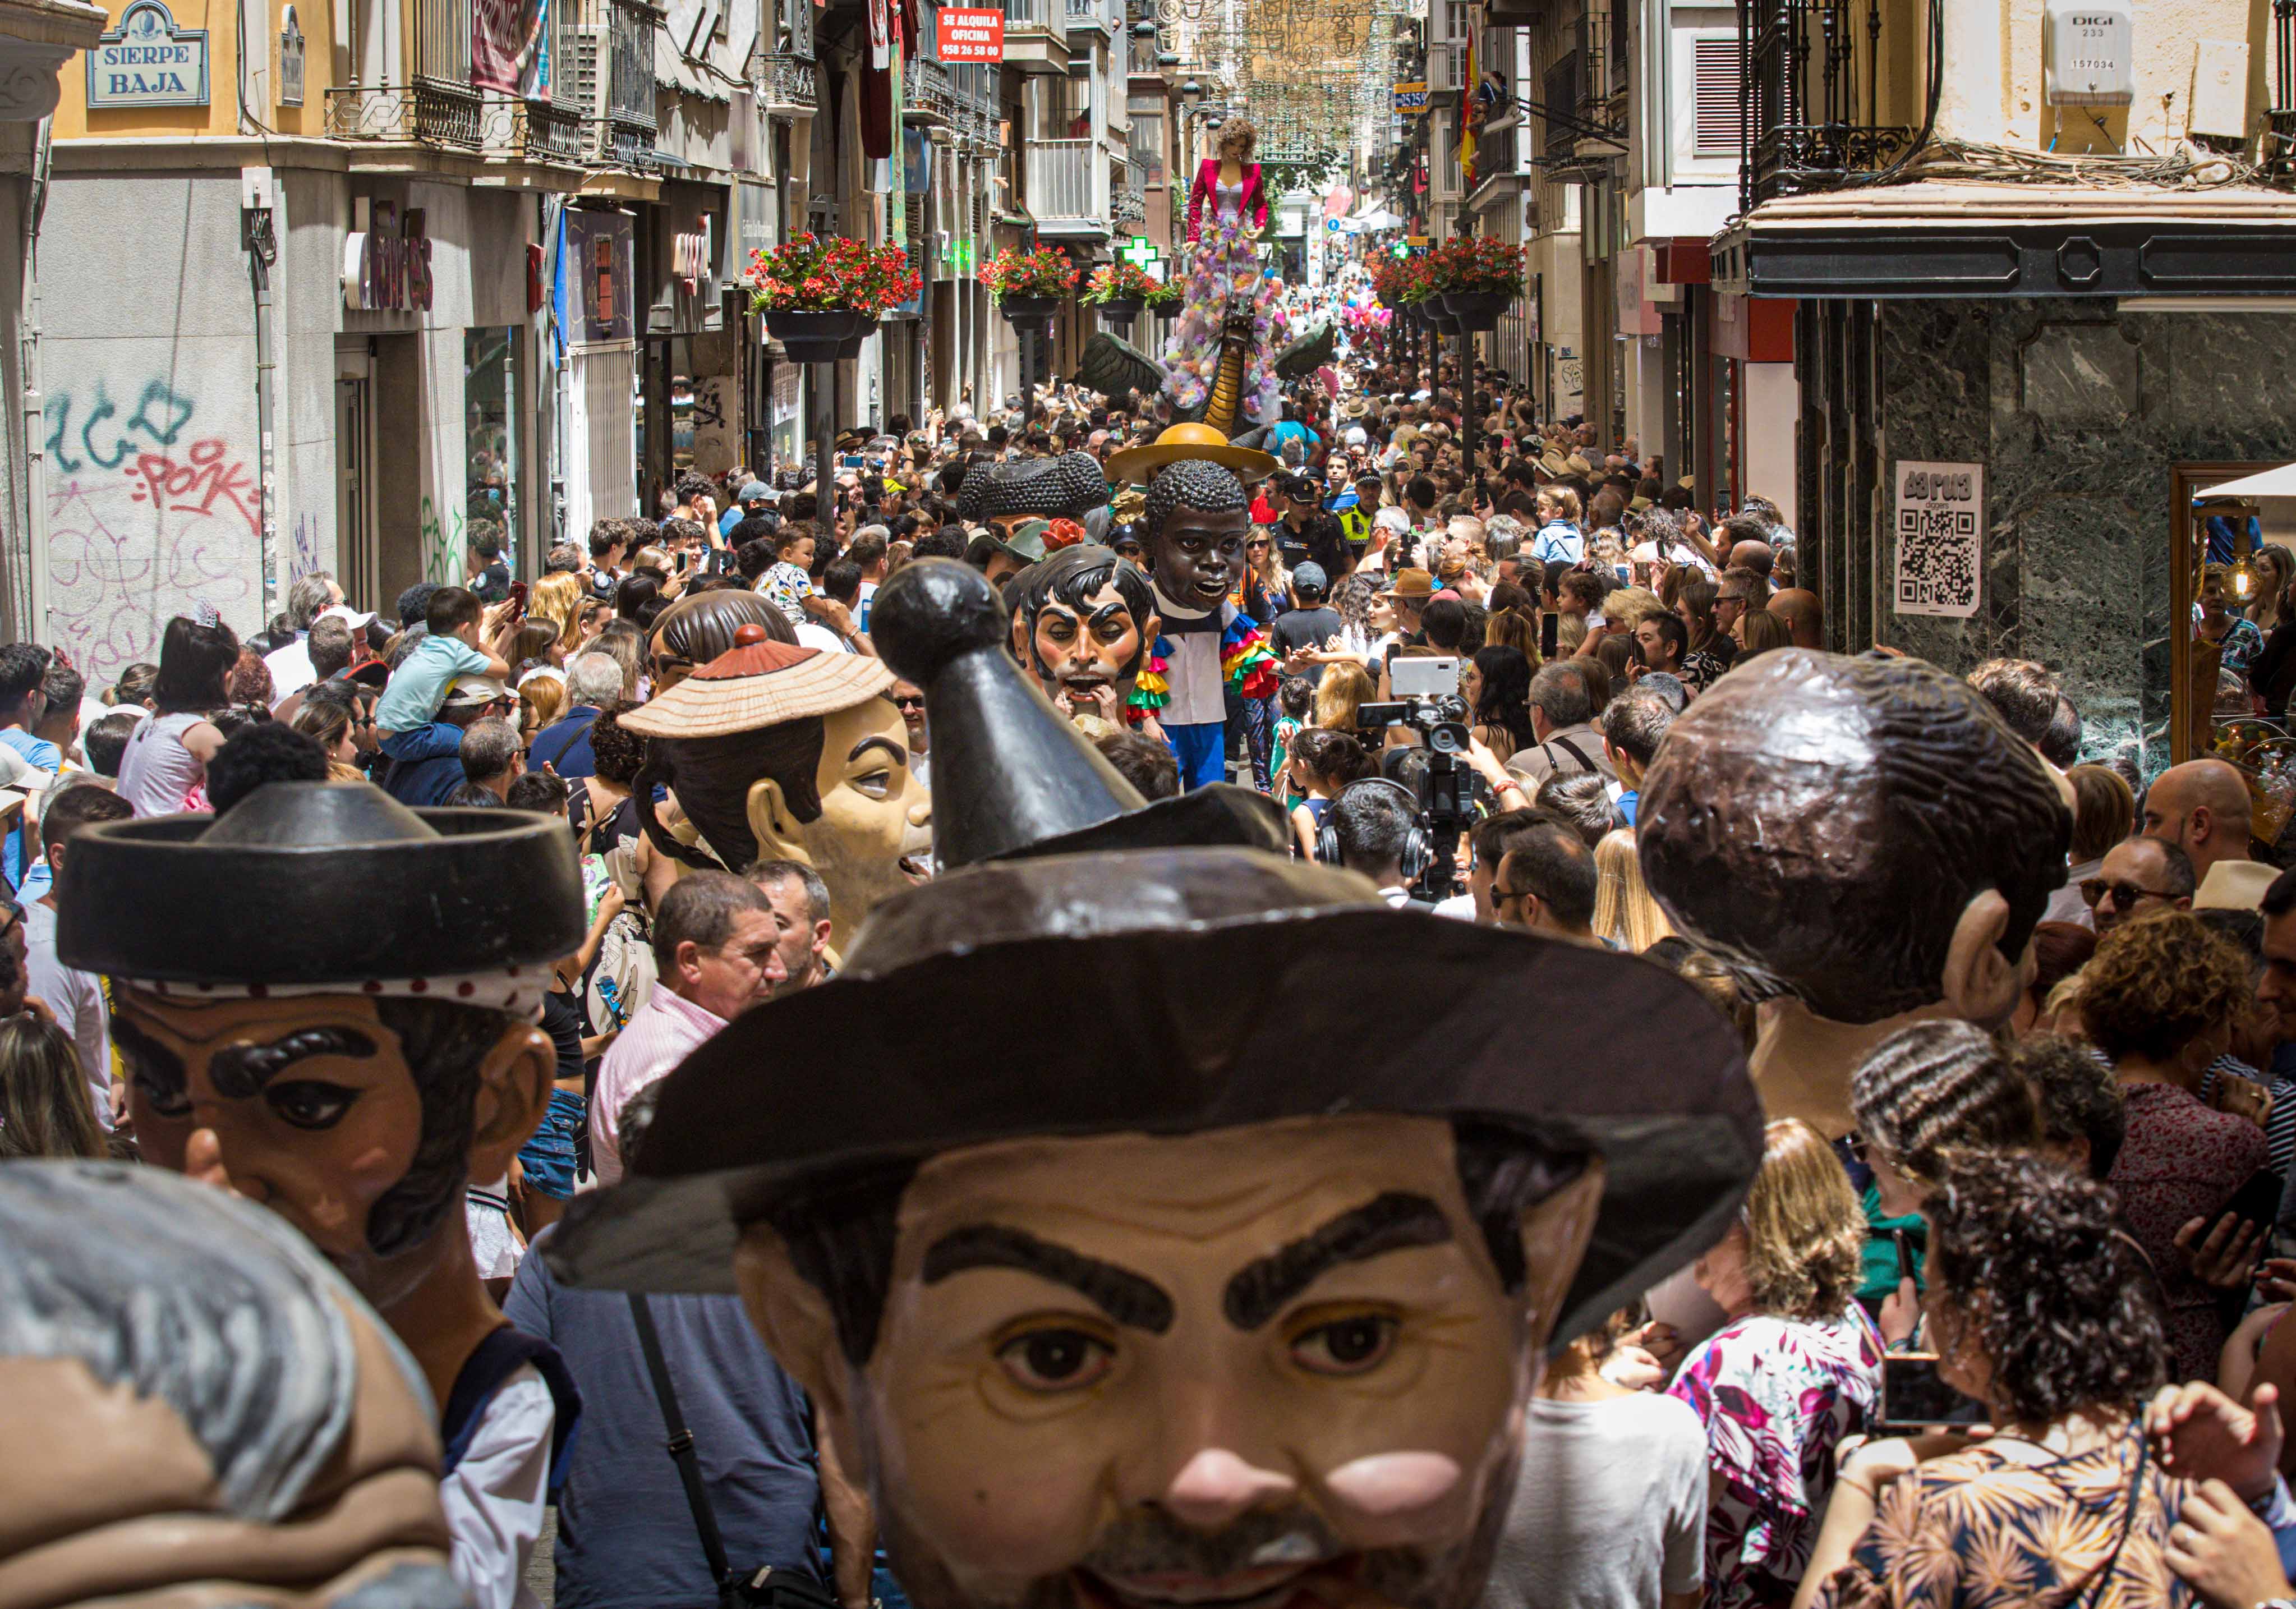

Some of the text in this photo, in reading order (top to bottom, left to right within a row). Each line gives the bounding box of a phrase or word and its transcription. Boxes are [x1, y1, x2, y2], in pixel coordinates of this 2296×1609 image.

[943, 14, 998, 27] SE ALQUILA
[2073, 17, 2113, 25] DIGI
[951, 29, 990, 42] OFICINA
[2082, 29, 2104, 37] 233
[104, 45, 189, 65] SIERPE
[942, 44, 999, 56] 958 26 58 00
[2073, 59, 2114, 68] 157034
[108, 72, 187, 94] BAJA
[1904, 471, 1972, 502] darua
[1925, 501, 1949, 511] diggers
